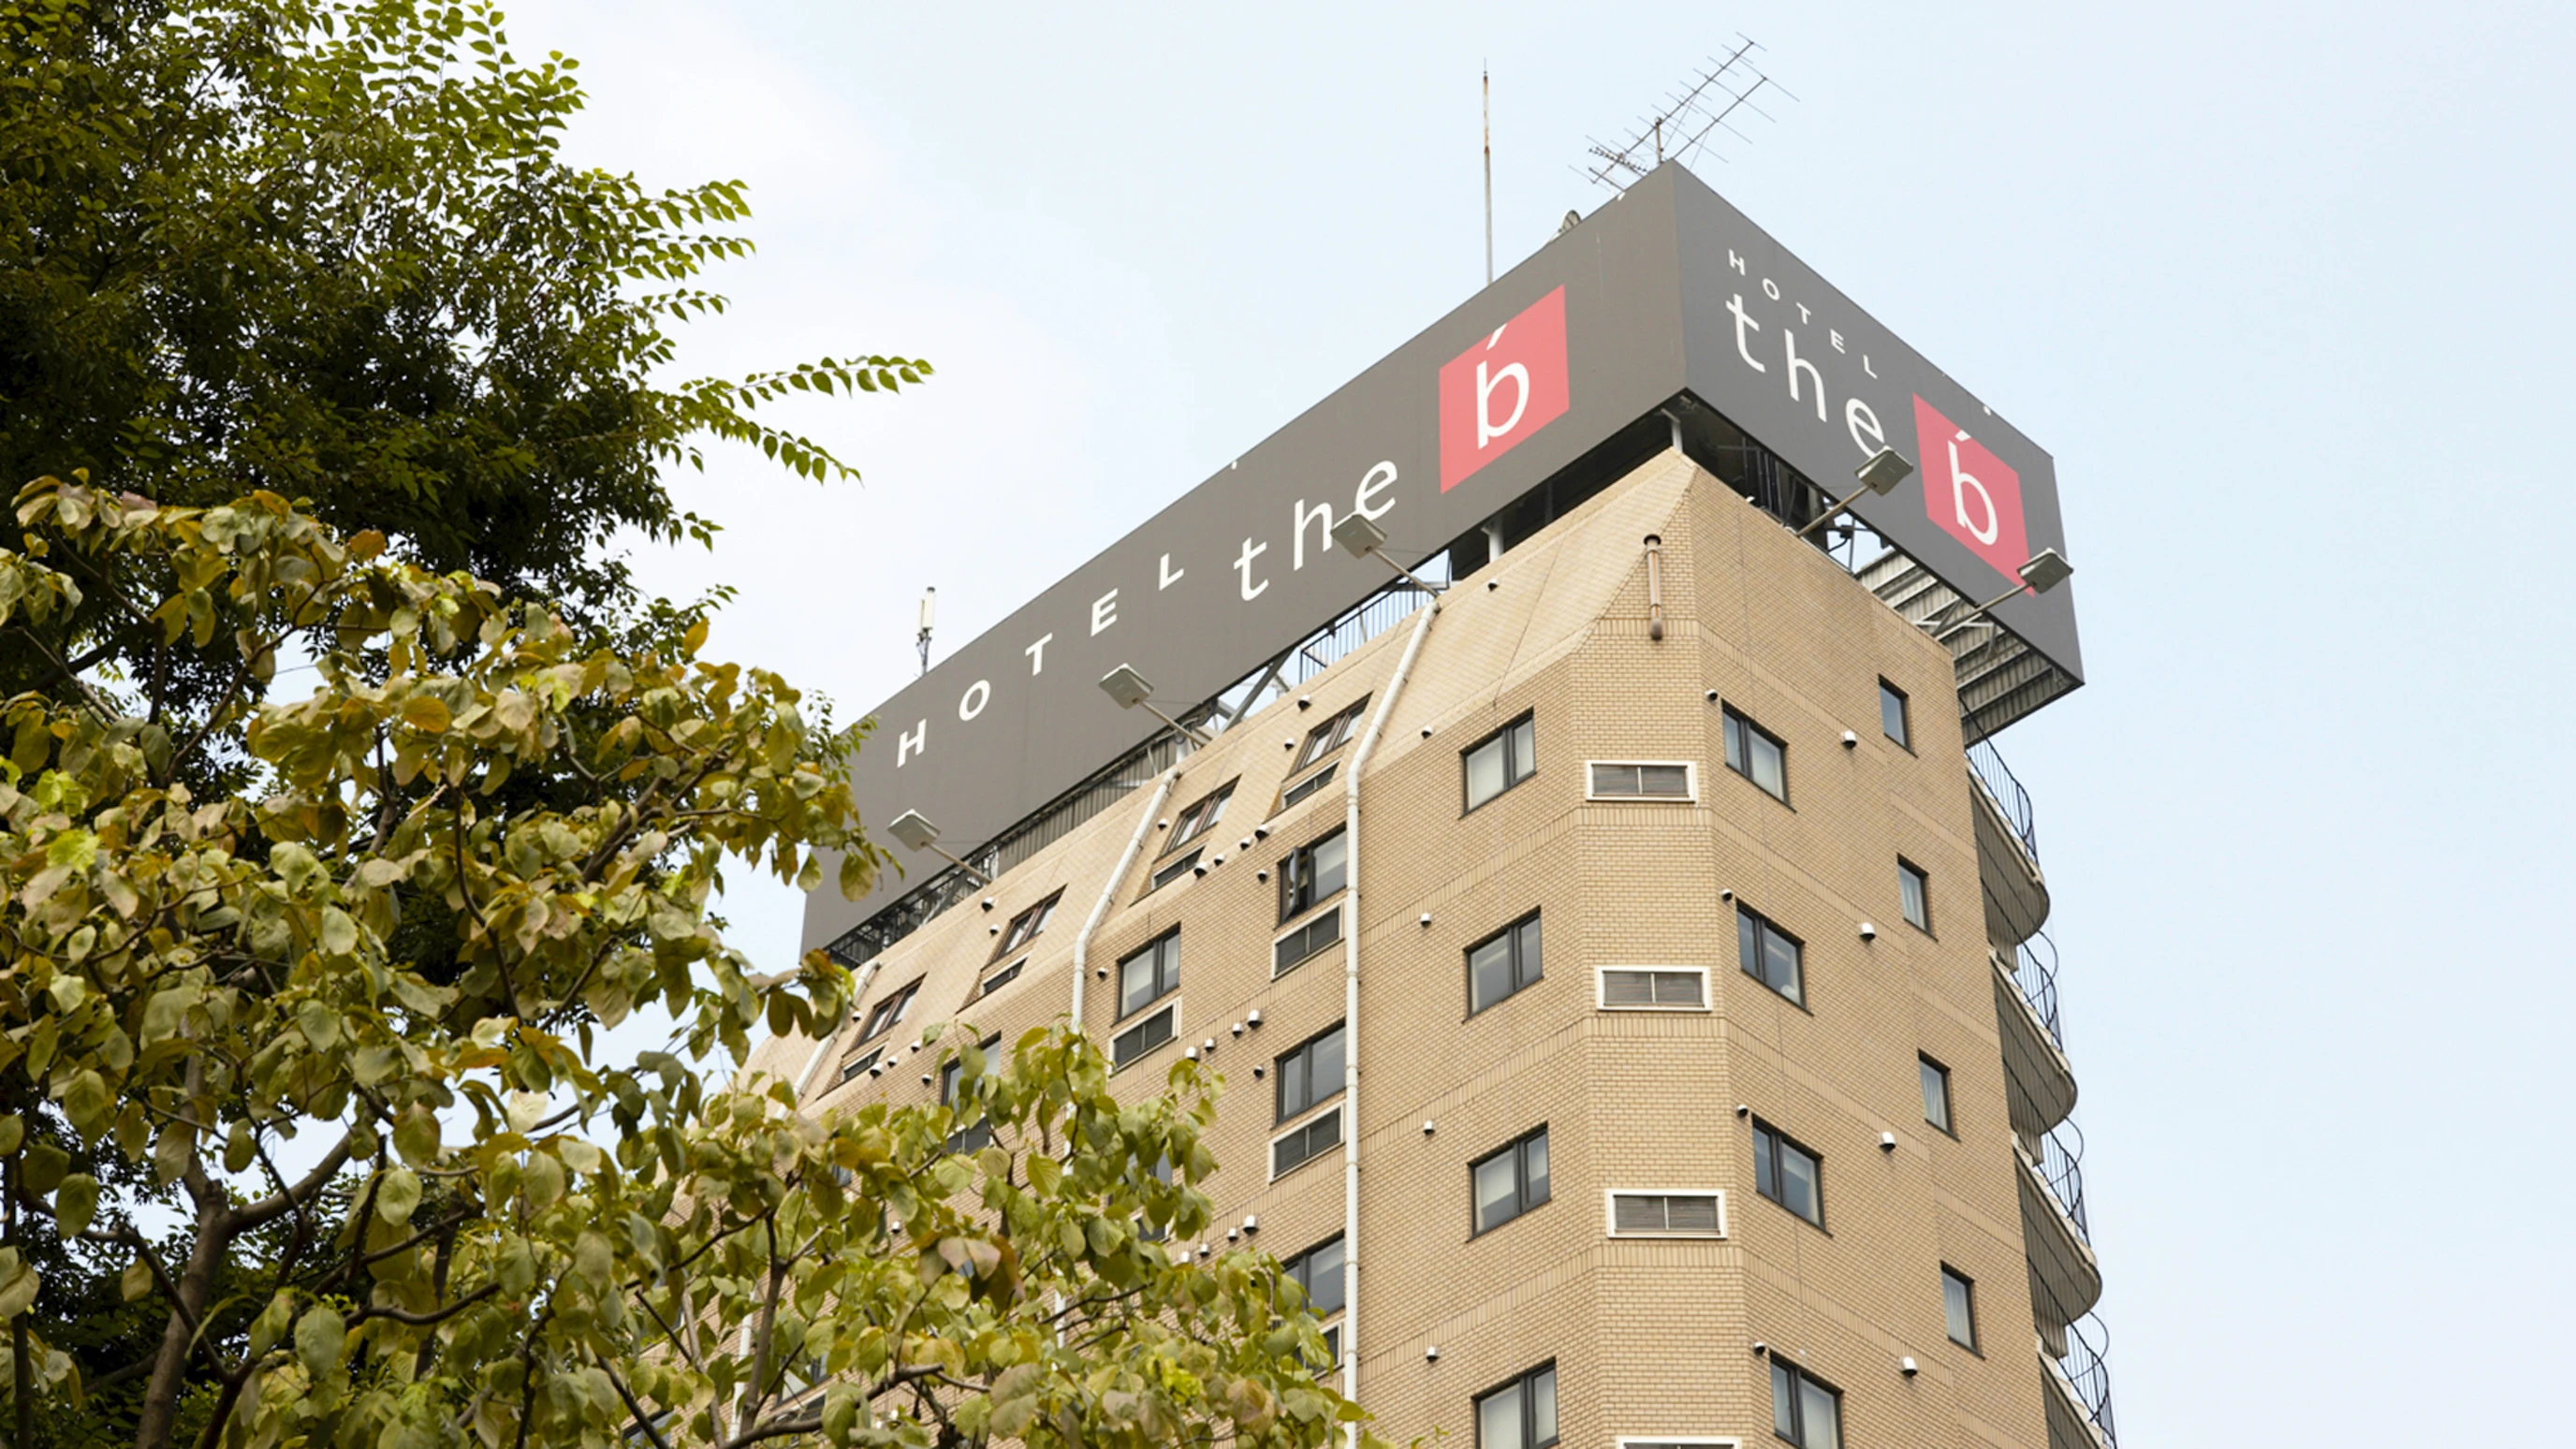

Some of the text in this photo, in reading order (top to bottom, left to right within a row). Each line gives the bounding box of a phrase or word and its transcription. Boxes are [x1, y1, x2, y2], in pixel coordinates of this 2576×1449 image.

[1725, 293, 1893, 461] the
[1728, 248, 1878, 380] HOTEL
[897, 552, 1185, 768] HOTEL
[1233, 460, 1398, 602] the
